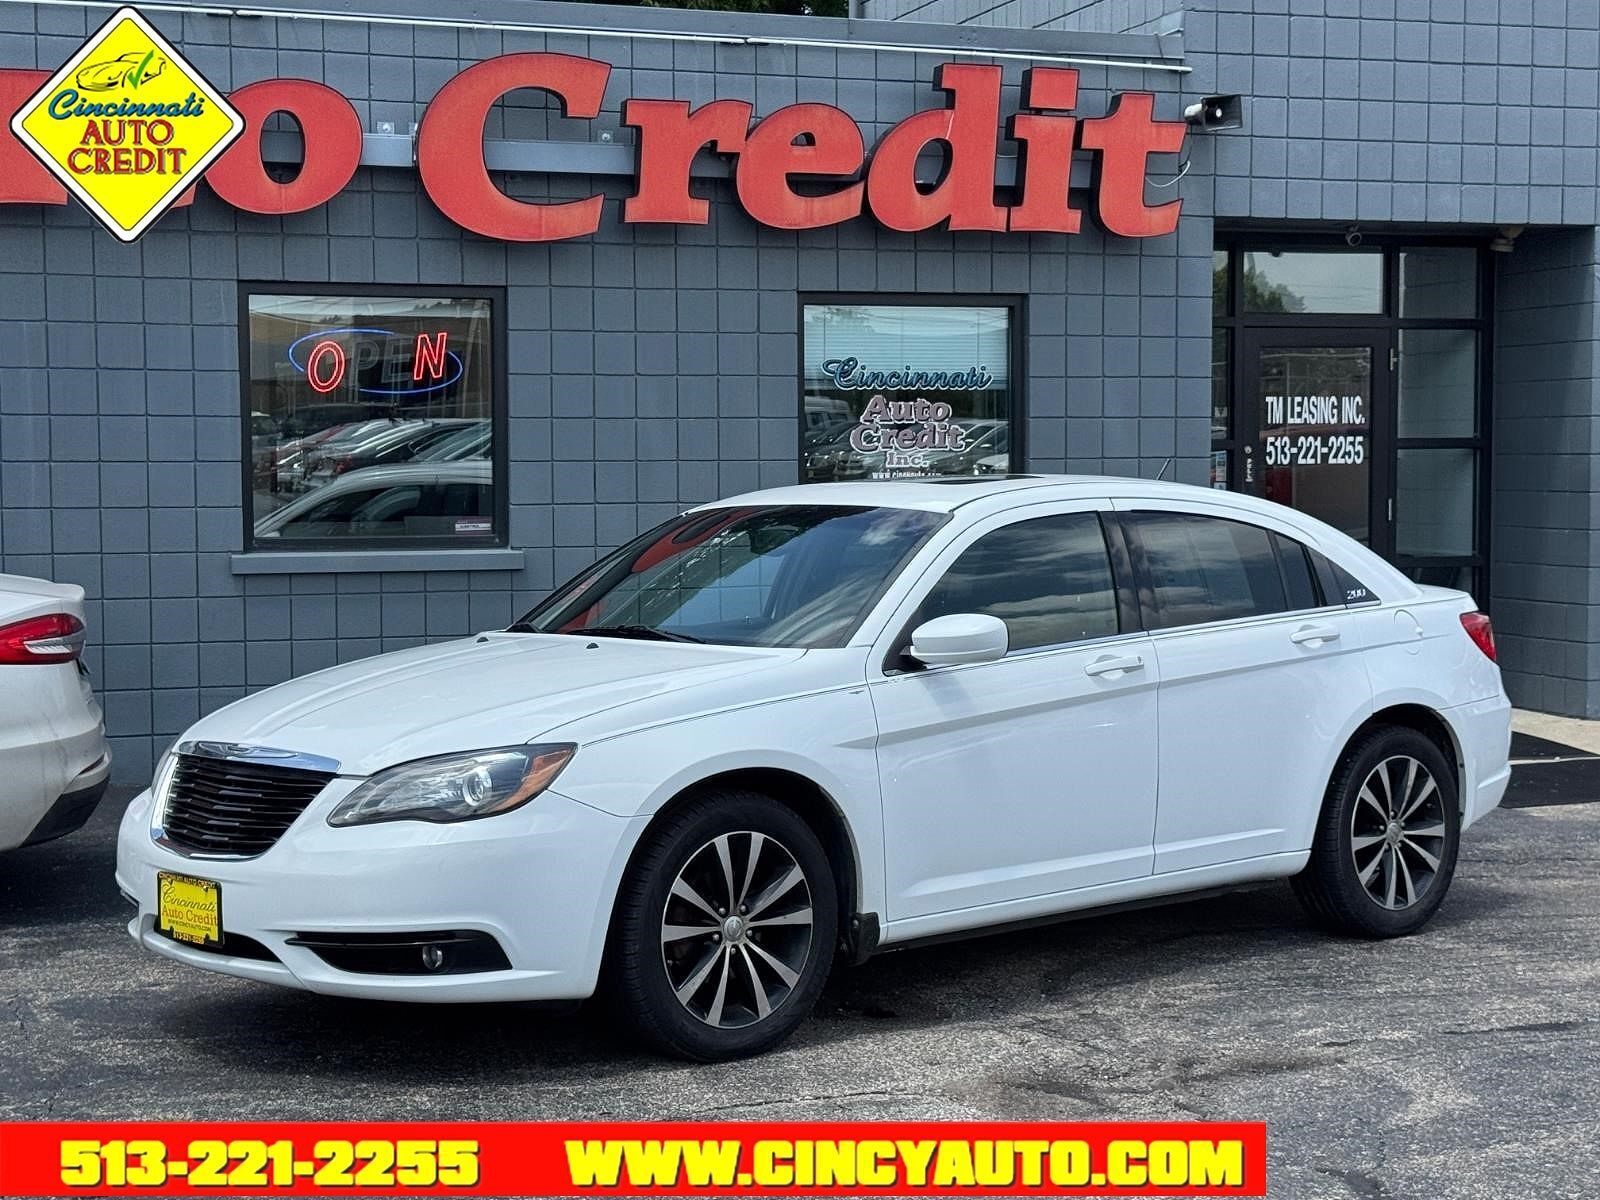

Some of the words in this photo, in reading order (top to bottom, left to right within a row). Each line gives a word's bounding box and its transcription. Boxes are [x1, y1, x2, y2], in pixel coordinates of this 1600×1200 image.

[416, 52, 1187, 243] Credit
[307, 332, 448, 396] OPEN
[821, 357, 992, 390] Cincinnati
[860, 395, 952, 424] Auto
[1265, 396, 1283, 424] TM
[1287, 395, 1338, 424] LEASING
[1341, 395, 1365, 424] INC.
[850, 420, 967, 454] Credit
[1265, 436, 1364, 465] 513-221-2255
[886, 451, 930, 467] Inc.
[162, 883, 217, 912] Cincinnati
[162, 905, 184, 920] Auto
